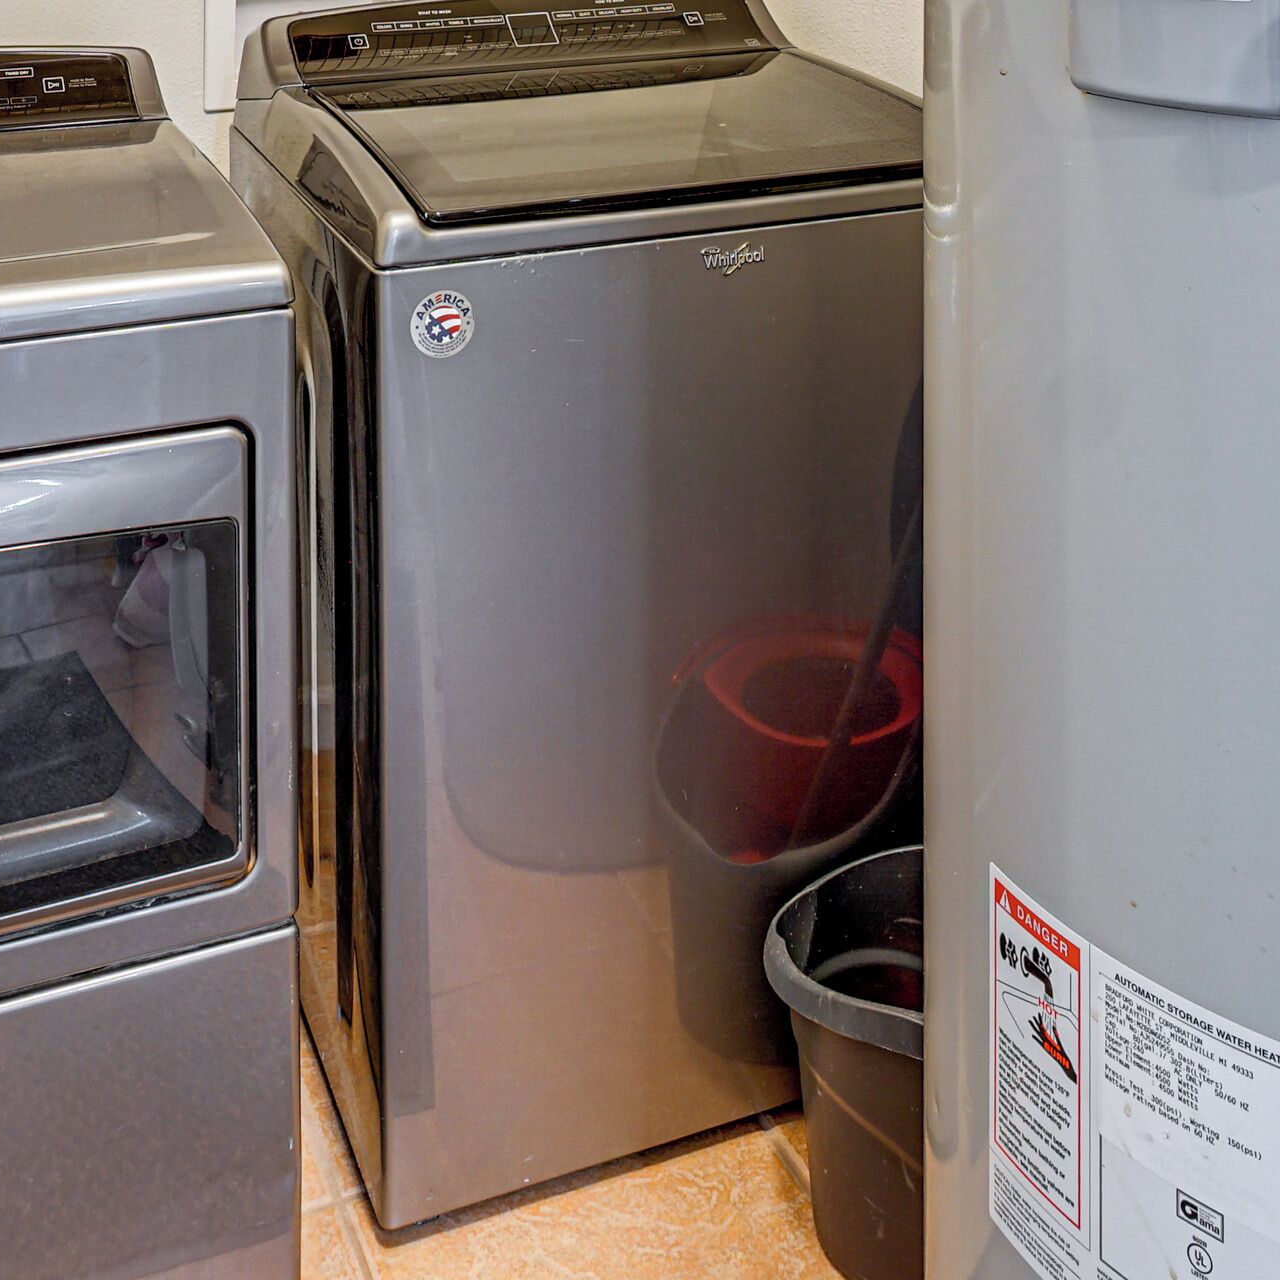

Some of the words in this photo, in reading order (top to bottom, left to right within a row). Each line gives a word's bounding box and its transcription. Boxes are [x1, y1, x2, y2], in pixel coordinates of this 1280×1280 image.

[702, 243, 765, 272] Whirlpool
[416, 293, 471, 321] AMERICA
[1016, 904, 1069, 957] DANGER
[1038, 995, 1059, 1020] HOT
[1114, 973, 1165, 1009] AUTOMATIC
[1167, 1002, 1214, 1034] STORAGE
[1216, 1027, 1252, 1052] WATER
[1231, 1063, 1254, 1080] 49333
